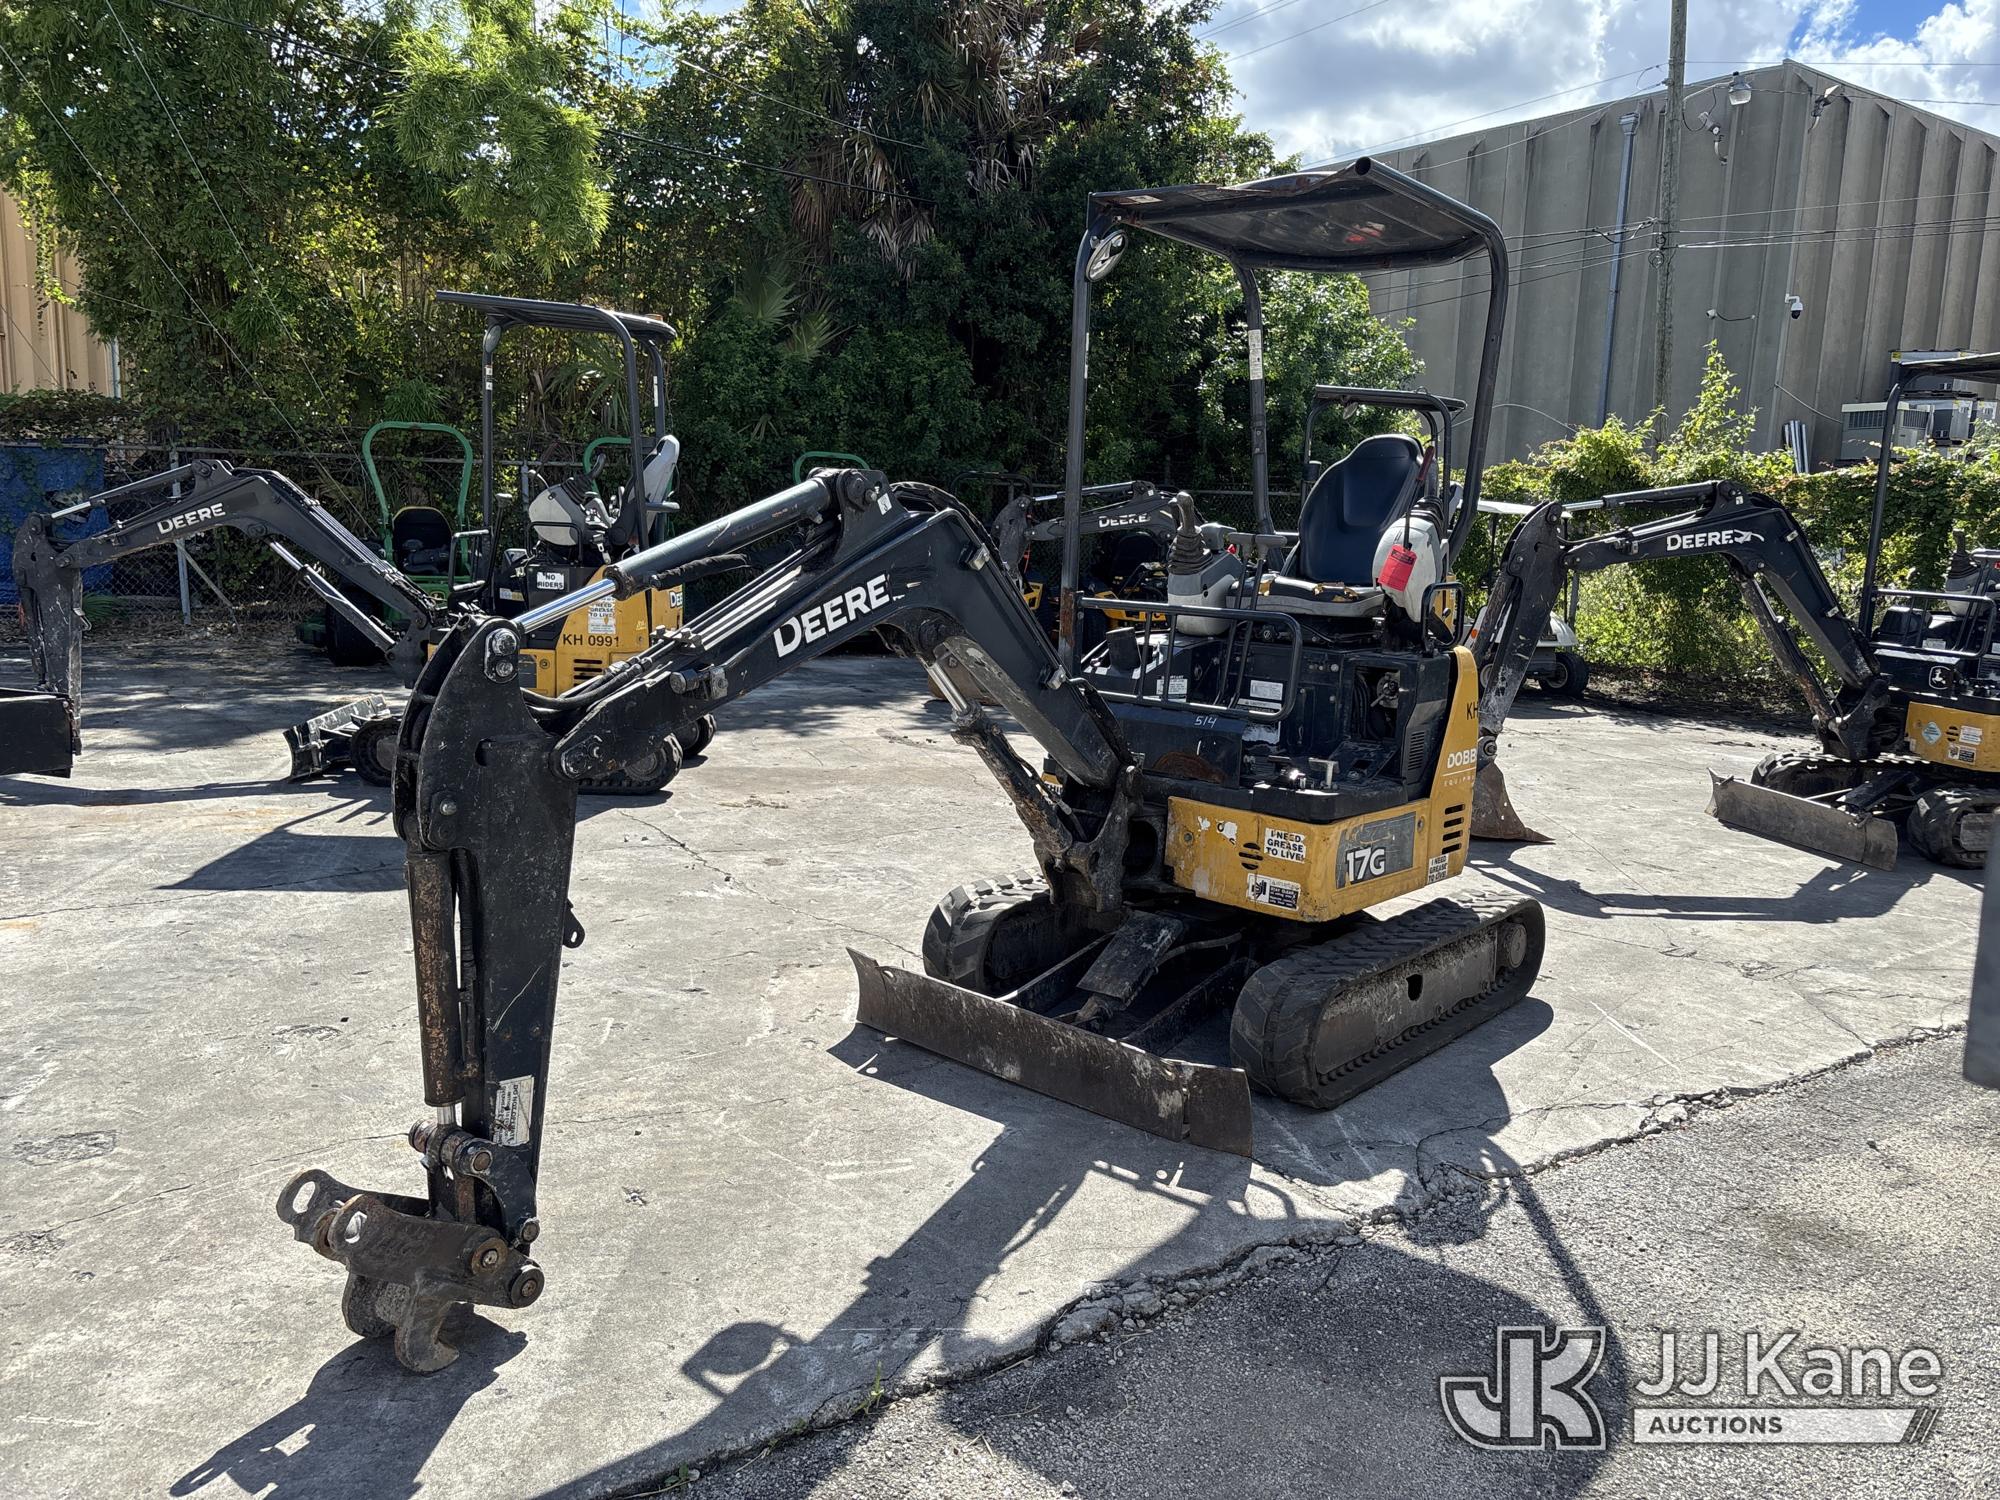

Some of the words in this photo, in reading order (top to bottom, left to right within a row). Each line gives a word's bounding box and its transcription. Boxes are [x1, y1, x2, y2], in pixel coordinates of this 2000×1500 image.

[157, 503, 226, 535] DEERE
[1098, 513, 1149, 528] DEERE
[1666, 529, 1734, 551] DEERE
[537, 581, 563, 589] RIDERS
[773, 573, 890, 658] DEERE
[563, 634, 583, 646] KH
[588, 635, 619, 647] 0991
[1466, 702, 1479, 720] KH
[1194, 715, 1217, 728] 514
[1266, 846, 1279, 857] TO
[1267, 838, 1304, 853] GREASE
[1346, 847, 1386, 882] 17G
[1434, 855, 1447, 865] NEED
